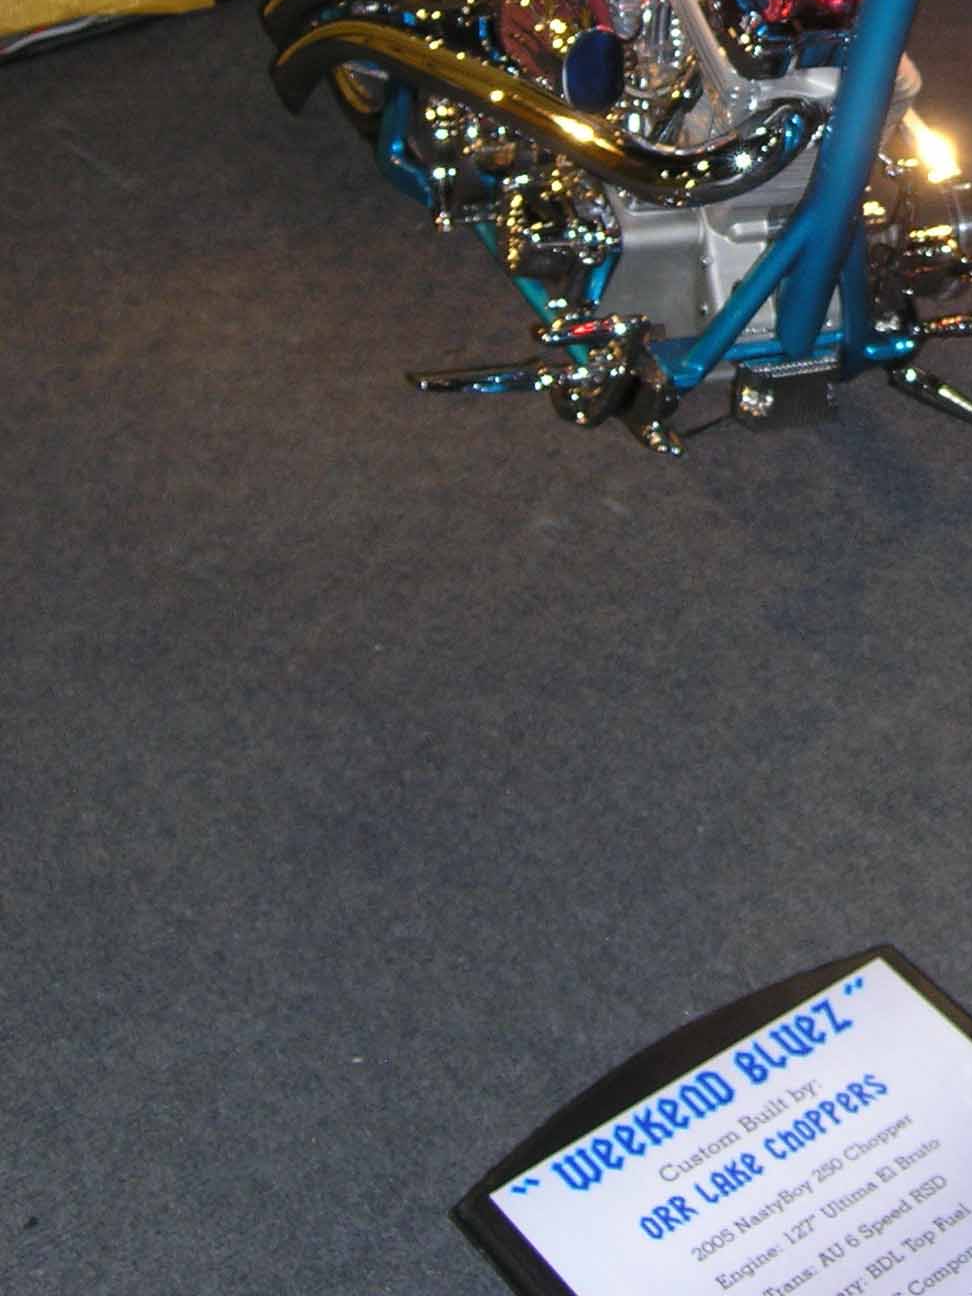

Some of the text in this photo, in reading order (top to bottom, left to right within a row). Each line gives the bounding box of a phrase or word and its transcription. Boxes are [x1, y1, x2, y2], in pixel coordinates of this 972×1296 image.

[659, 1078, 822, 1183] Custom Built by:
[640, 1195, 699, 1240] ORR
[693, 1152, 763, 1204] LAKE
[691, 1113, 913, 1262] 2005 NastyBoy 250 Chopper
[715, 1244, 785, 1290] Engine:
[820, 1180, 879, 1219] Ultima
[874, 1165, 898, 1183] El
[893, 1138, 941, 1172] Bruto
[817, 1242, 846, 1268] AU
[844, 1233, 860, 1249] 6
[857, 1199, 913, 1240] Speed
[908, 1174, 948, 1204] RSD
[865, 1250, 905, 1280] BDL
[901, 1229, 936, 1254] Top
[931, 1203, 972, 1234] Fuel
